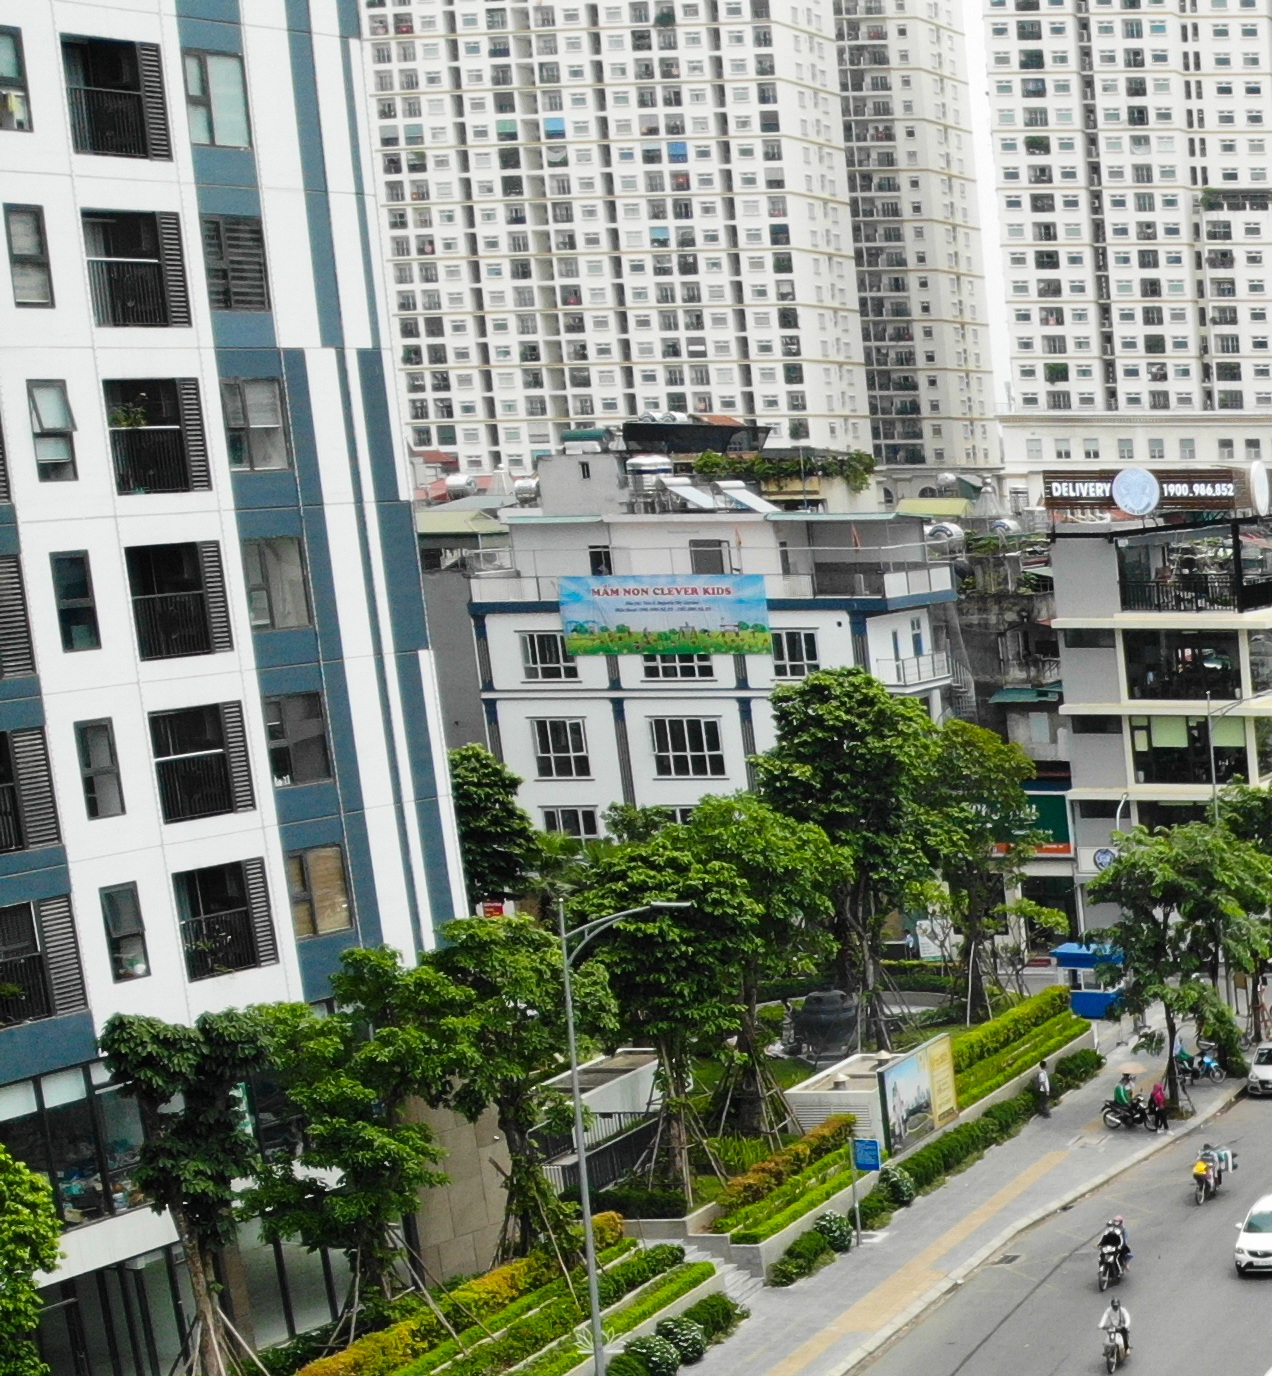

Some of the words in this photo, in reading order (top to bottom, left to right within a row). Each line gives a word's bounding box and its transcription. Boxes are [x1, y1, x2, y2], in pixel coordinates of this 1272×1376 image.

[1052, 482, 1112, 497] DELIVERY
[623, 587, 649, 596] NON
[652, 587, 699, 596] CLEVER
[702, 587, 732, 596] KIDS
